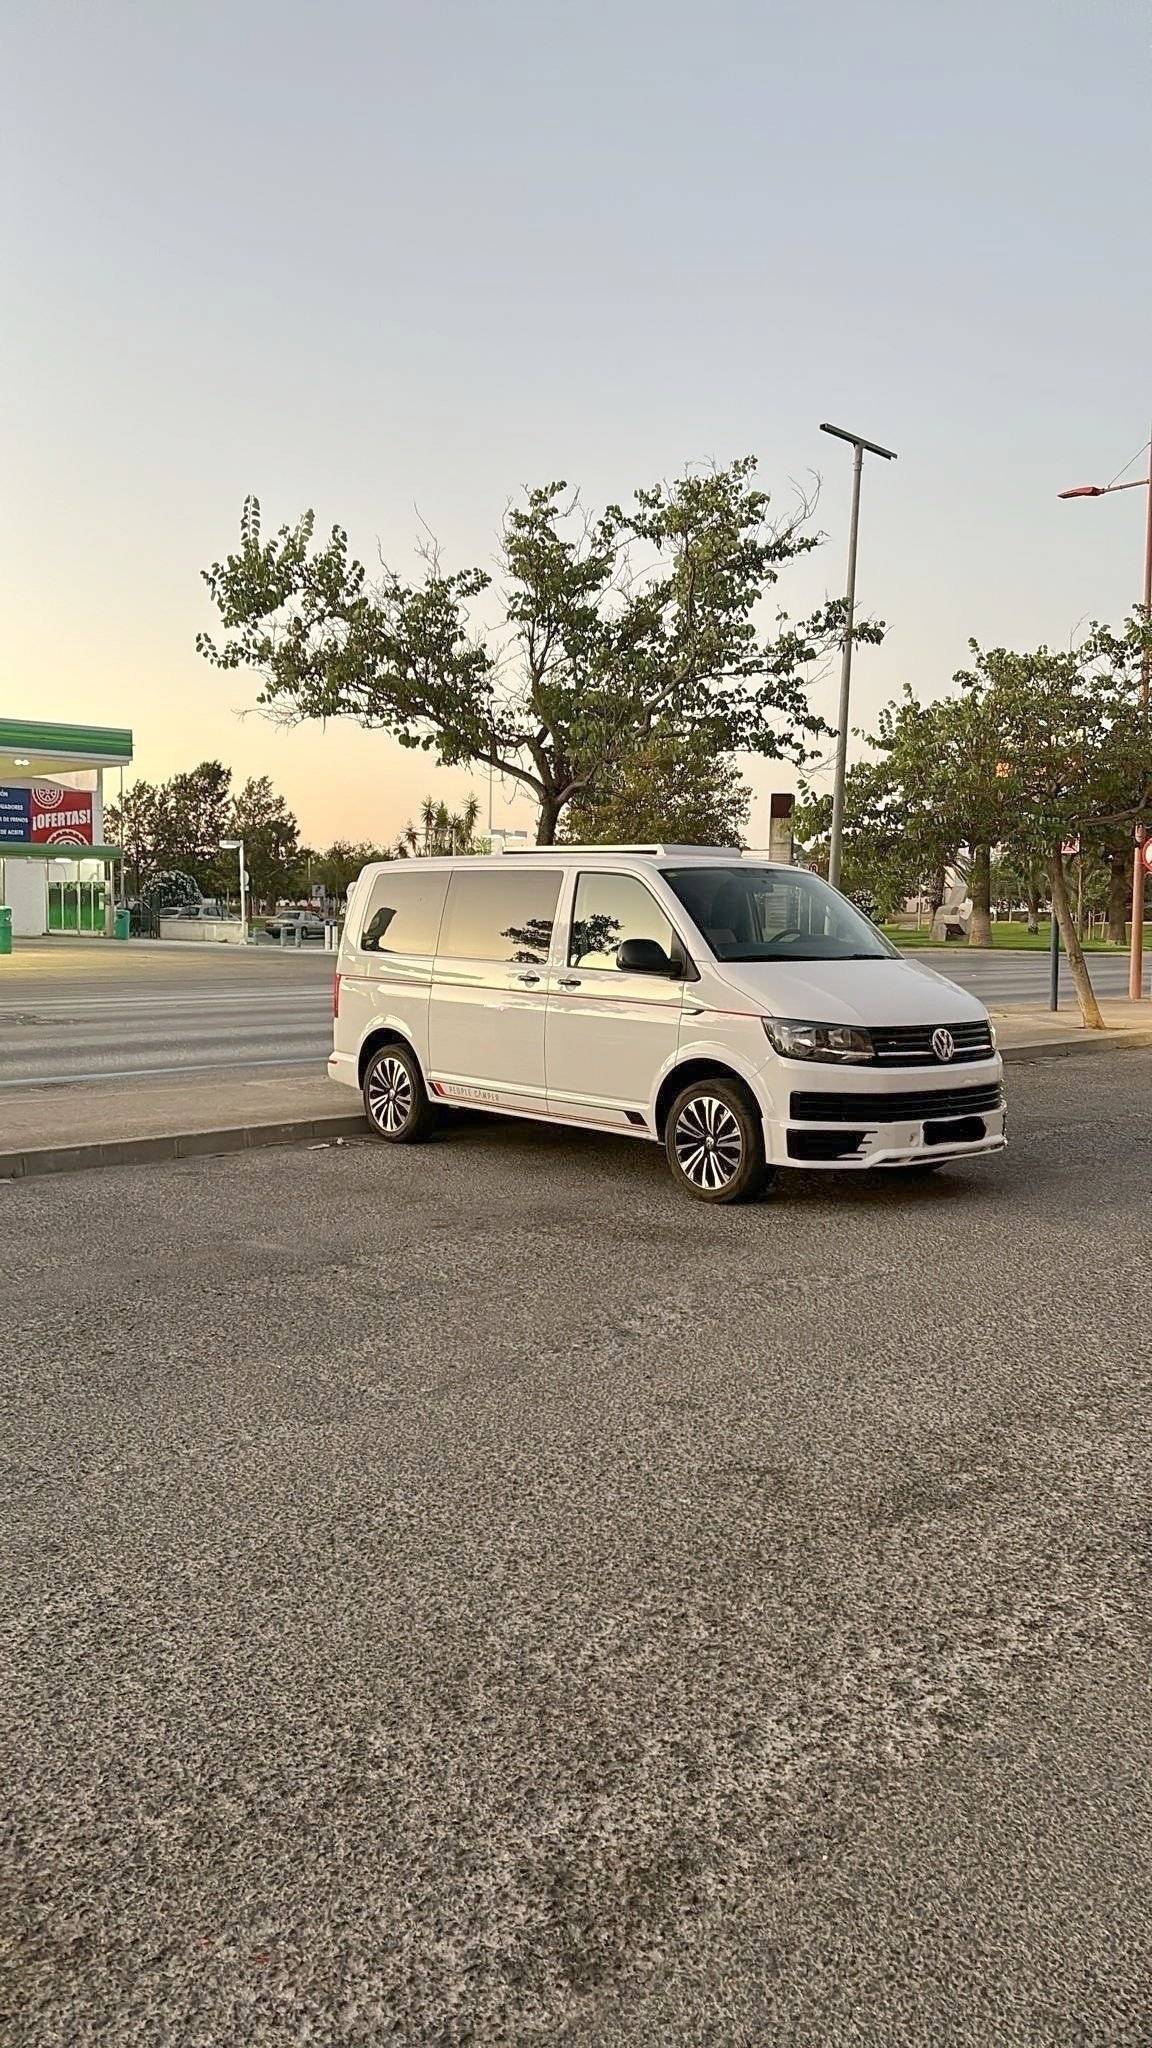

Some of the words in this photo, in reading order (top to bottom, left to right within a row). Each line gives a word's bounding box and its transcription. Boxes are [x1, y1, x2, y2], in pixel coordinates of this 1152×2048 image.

[32, 809, 91, 831] ¡OFERTAS!
[449, 1086, 472, 1097] PEOPLE
[474, 1090, 499, 1101] CAMPER
